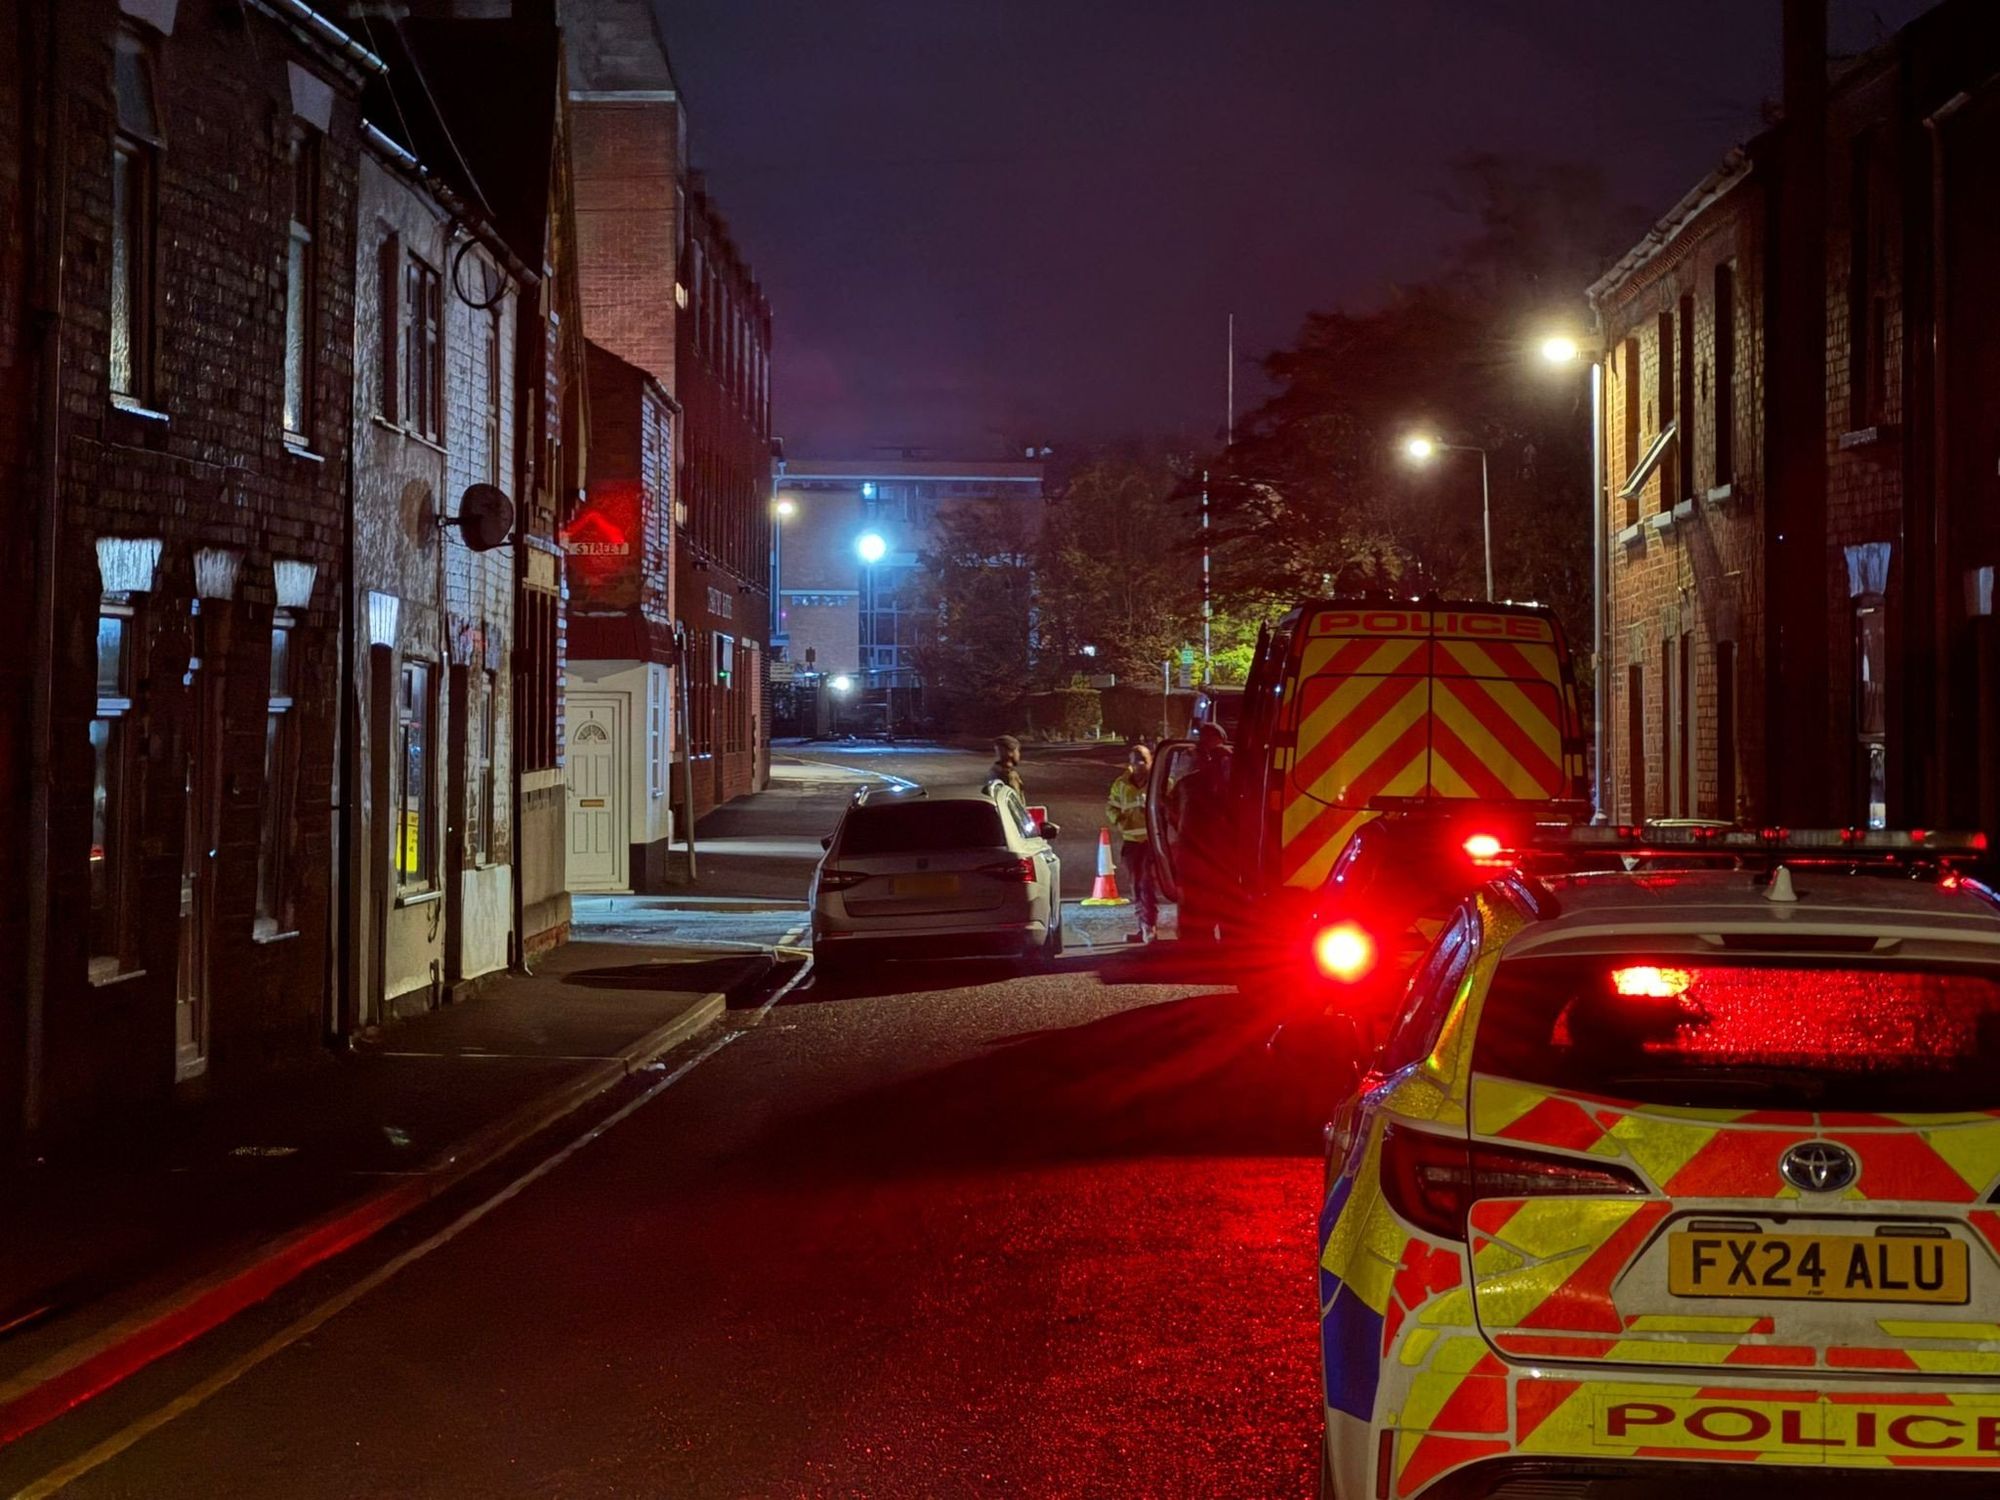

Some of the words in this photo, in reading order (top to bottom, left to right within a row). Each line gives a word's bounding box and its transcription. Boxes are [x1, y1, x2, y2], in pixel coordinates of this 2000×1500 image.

[576, 543, 624, 554] STREET
[1319, 612, 1543, 638] POLICE
[1692, 1240, 1826, 1286] FX24
[1845, 1243, 1944, 1290] ALU
